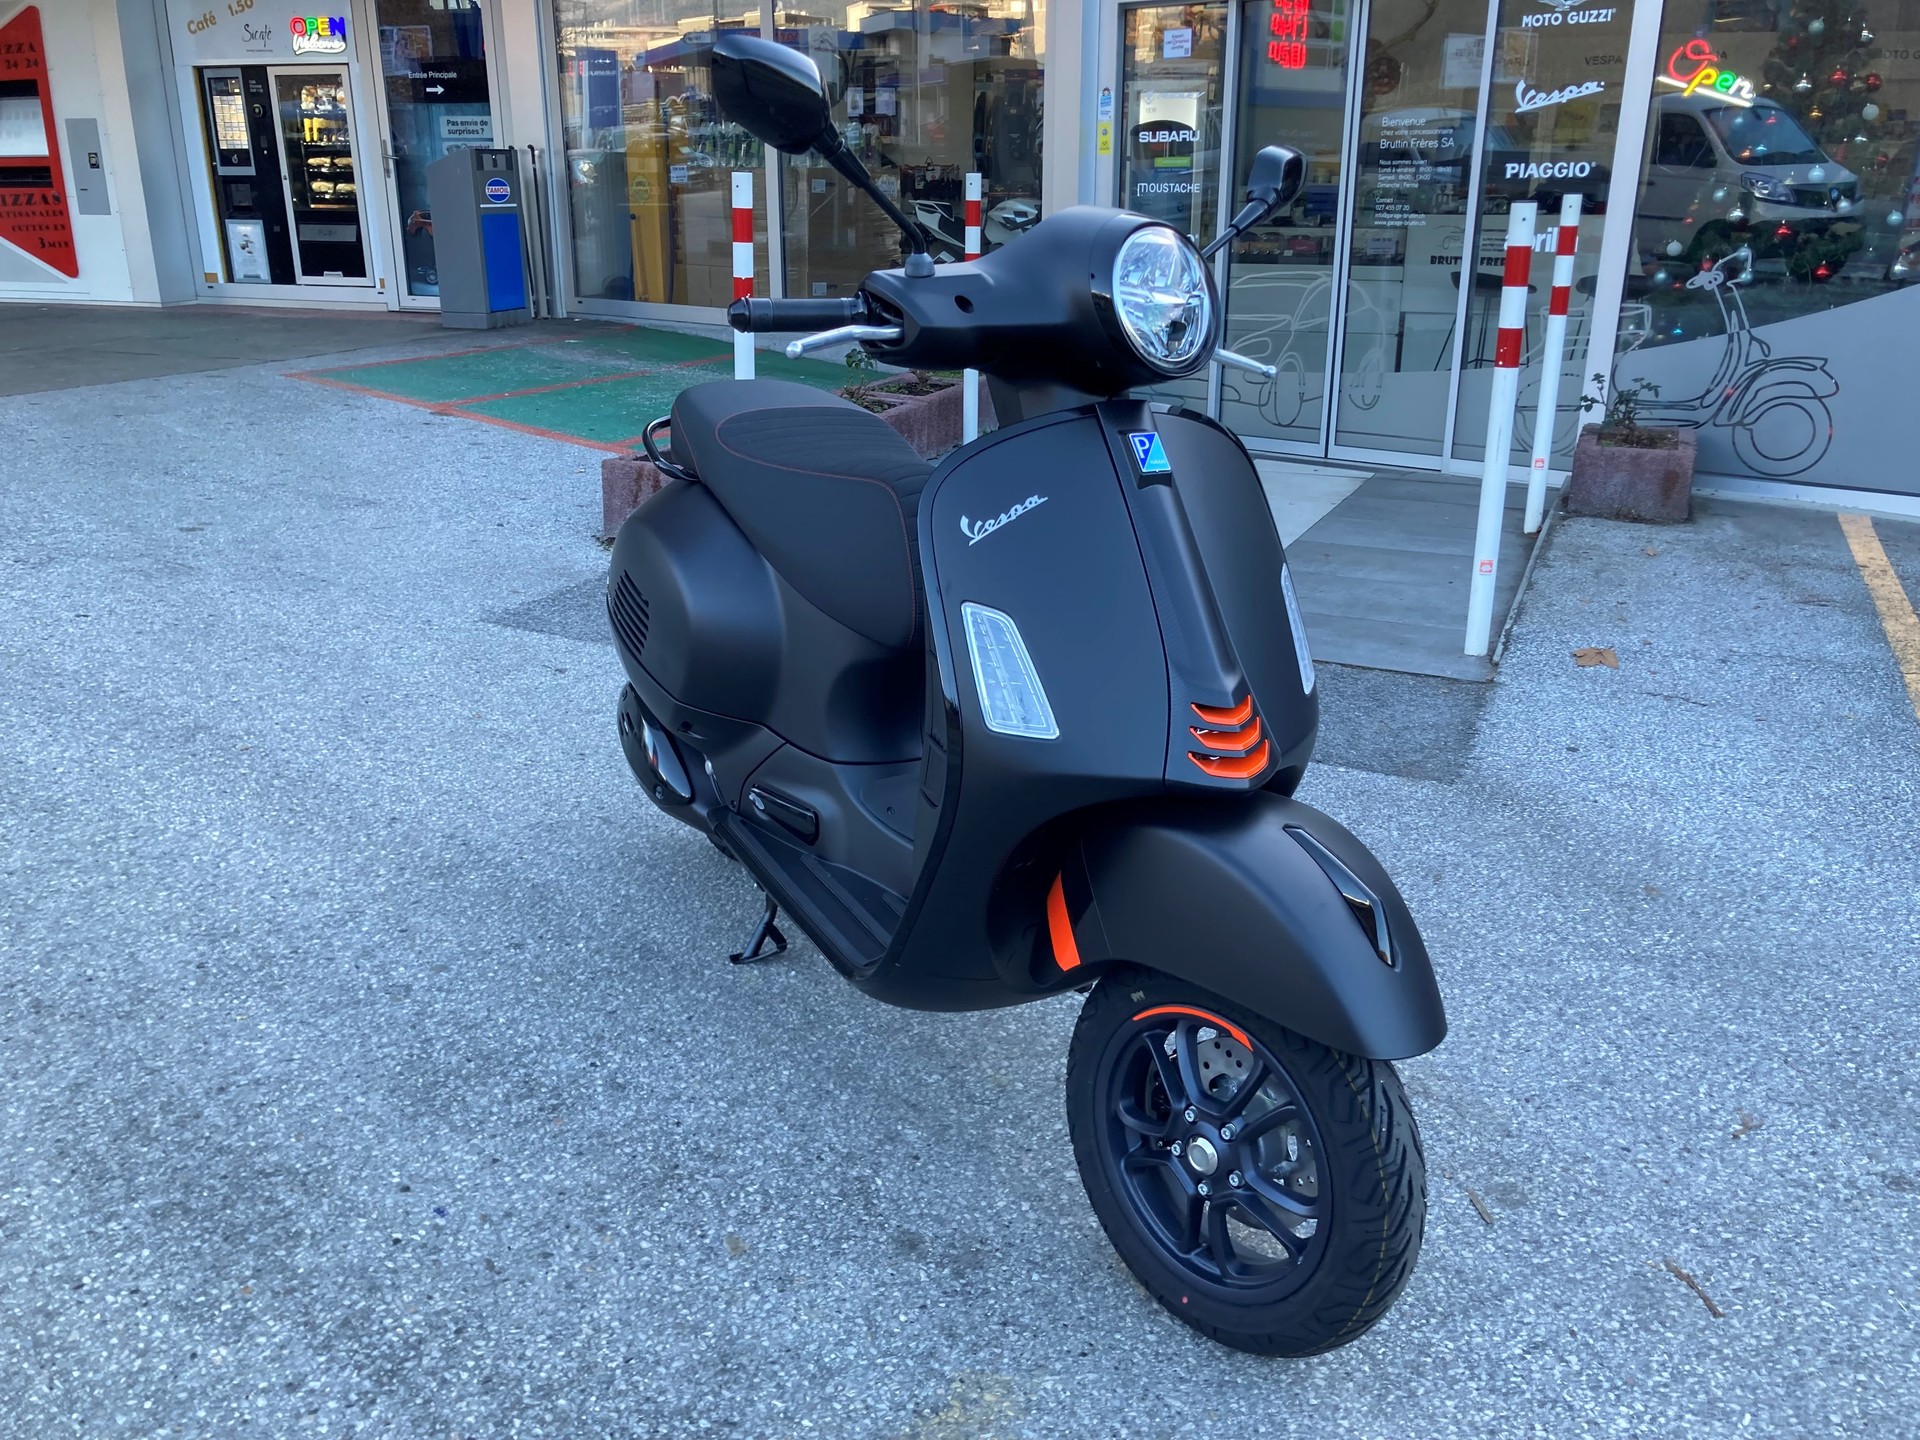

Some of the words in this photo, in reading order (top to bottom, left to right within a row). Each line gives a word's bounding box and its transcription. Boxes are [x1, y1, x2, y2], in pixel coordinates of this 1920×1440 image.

[187, 10, 217, 35] Café
[228, 0, 255, 17] 1.50
[1522, 12, 1562, 28] MOTO
[1567, 9, 1612, 25] GUZZI
[290, 16, 346, 37] OPEN
[242, 23, 272, 48] Sicafé
[292, 30, 347, 55] Welcome
[1585, 55, 1623, 66] VESPA
[1667, 39, 1756, 98] Open
[408, 71, 428, 79] Entrée
[428, 71, 457, 80] Principale
[1515, 79, 1605, 113] Vespa
[446, 119, 459, 127] Pas
[460, 119, 479, 127] envie
[479, 119, 489, 127] de
[1381, 116, 1426, 127] Bienvenue
[447, 127, 479, 136] surprises
[1138, 130, 1200, 143] SUBARU
[1380, 138, 1408, 149] Bruttin
[1410, 137, 1439, 149] Frères
[1441, 137, 1455, 148] SA
[1505, 162, 1591, 178] PIAGGIO
[486, 186, 510, 194] TAMOIL
[1133, 436, 1150, 459] P
[960, 494, 1049, 546] Vespa
